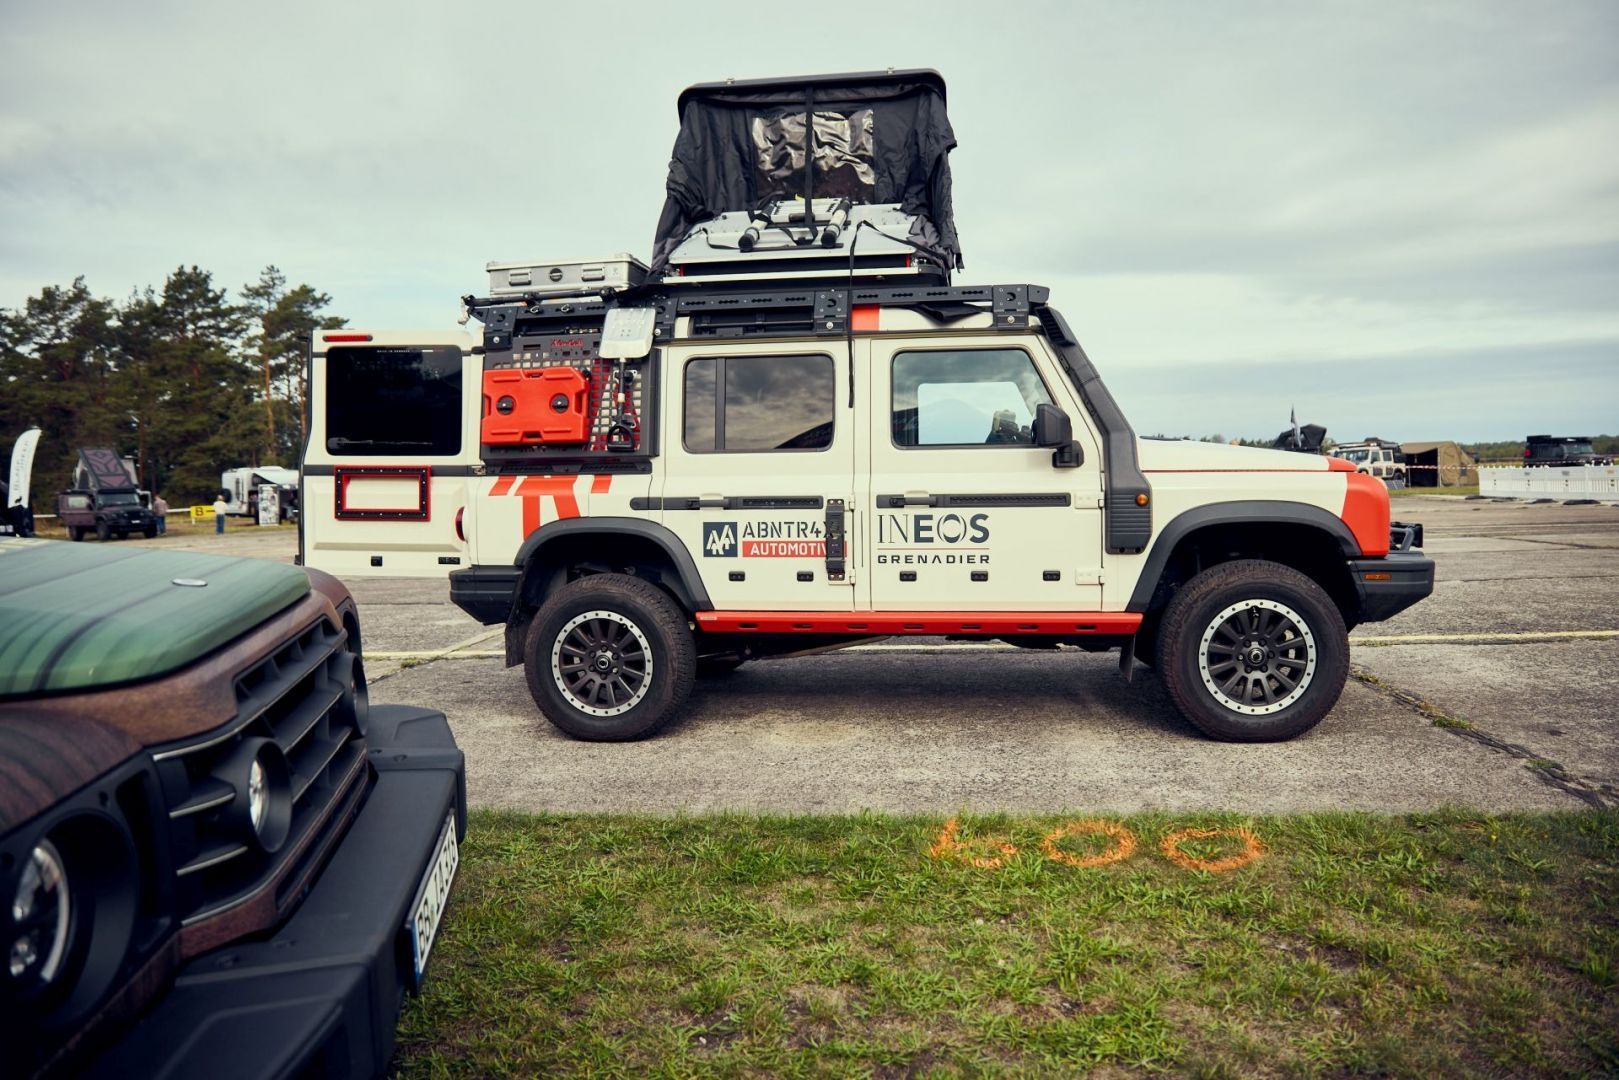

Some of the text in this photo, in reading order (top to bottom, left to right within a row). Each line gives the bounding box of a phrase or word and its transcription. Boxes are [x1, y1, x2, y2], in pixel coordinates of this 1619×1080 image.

[195, 506, 204, 516] B
[742, 521, 847, 538] ABNTR4
[877, 513, 990, 543] INEOS
[750, 543, 827, 556] AUTOMOTIV
[877, 555, 990, 564] GRENADIER
